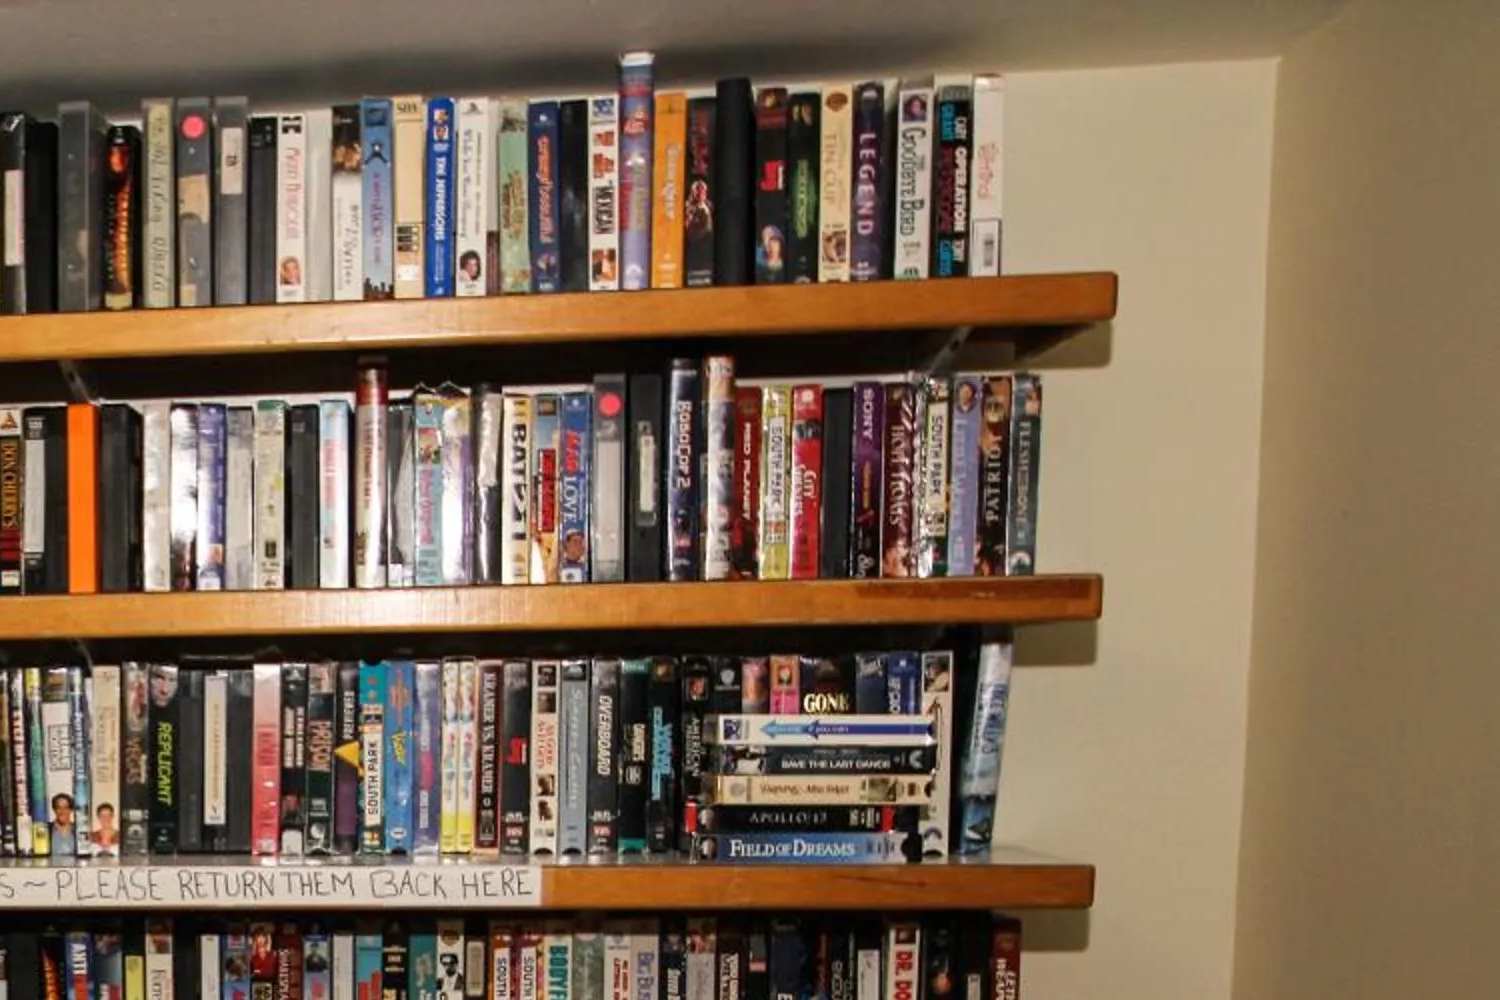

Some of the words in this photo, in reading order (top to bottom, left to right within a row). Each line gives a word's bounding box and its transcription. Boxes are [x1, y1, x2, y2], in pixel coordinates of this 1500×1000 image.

[824, 132, 838, 161] TIN
[823, 164, 838, 206] CUP
[856, 132, 877, 236] LEGEND
[953, 147, 967, 232] OPERATION
[594, 187, 613, 235] MEXICAN
[862, 388, 874, 440] SONY
[678, 400, 693, 472] ROBOCOP
[743, 422, 752, 455] RED
[771, 427, 783, 467] SOUTH
[930, 415, 943, 459] SOUTH
[1018, 421, 1032, 470] FLESH
[678, 476, 691, 489] 2
[742, 459, 752, 521] PLANET
[771, 471, 782, 508] PARK
[804, 469, 818, 501] CITY
[930, 462, 942, 498] PARK
[984, 433, 1003, 524] PATRIOT
[563, 475, 578, 524] LOVE
[481, 672, 496, 723] KRAMER
[597, 695, 613, 776] OVERBOARD
[690, 717, 702, 776] AMERICAN
[125, 740, 141, 784] VEGAS
[156, 721, 173, 806] REPLICANT
[367, 741, 379, 772] PARK
[481, 745, 496, 793] KRAMER
[781, 758, 807, 769] SAVE
[808, 758, 825, 769] THE
[829, 758, 852, 769] LAST
[855, 758, 891, 769] DANCE
[366, 775, 379, 815] SOUTH
[748, 811, 808, 824] APOLLO
[812, 811, 828, 824] 13
[729, 839, 774, 856] FIELD
[775, 841, 791, 856] OF
[791, 838, 855, 856] DREAMS
[56, 869, 160, 901] PLEASE
[179, 870, 276, 899] RETURN
[279, 871, 357, 898] THEM
[371, 869, 448, 899] BACK
[461, 868, 534, 898] HERE
[496, 957, 507, 997] SOUTH
[523, 955, 535, 996] SOUTH
[637, 951, 655, 974] BIG
[894, 951, 913, 976] DR.
